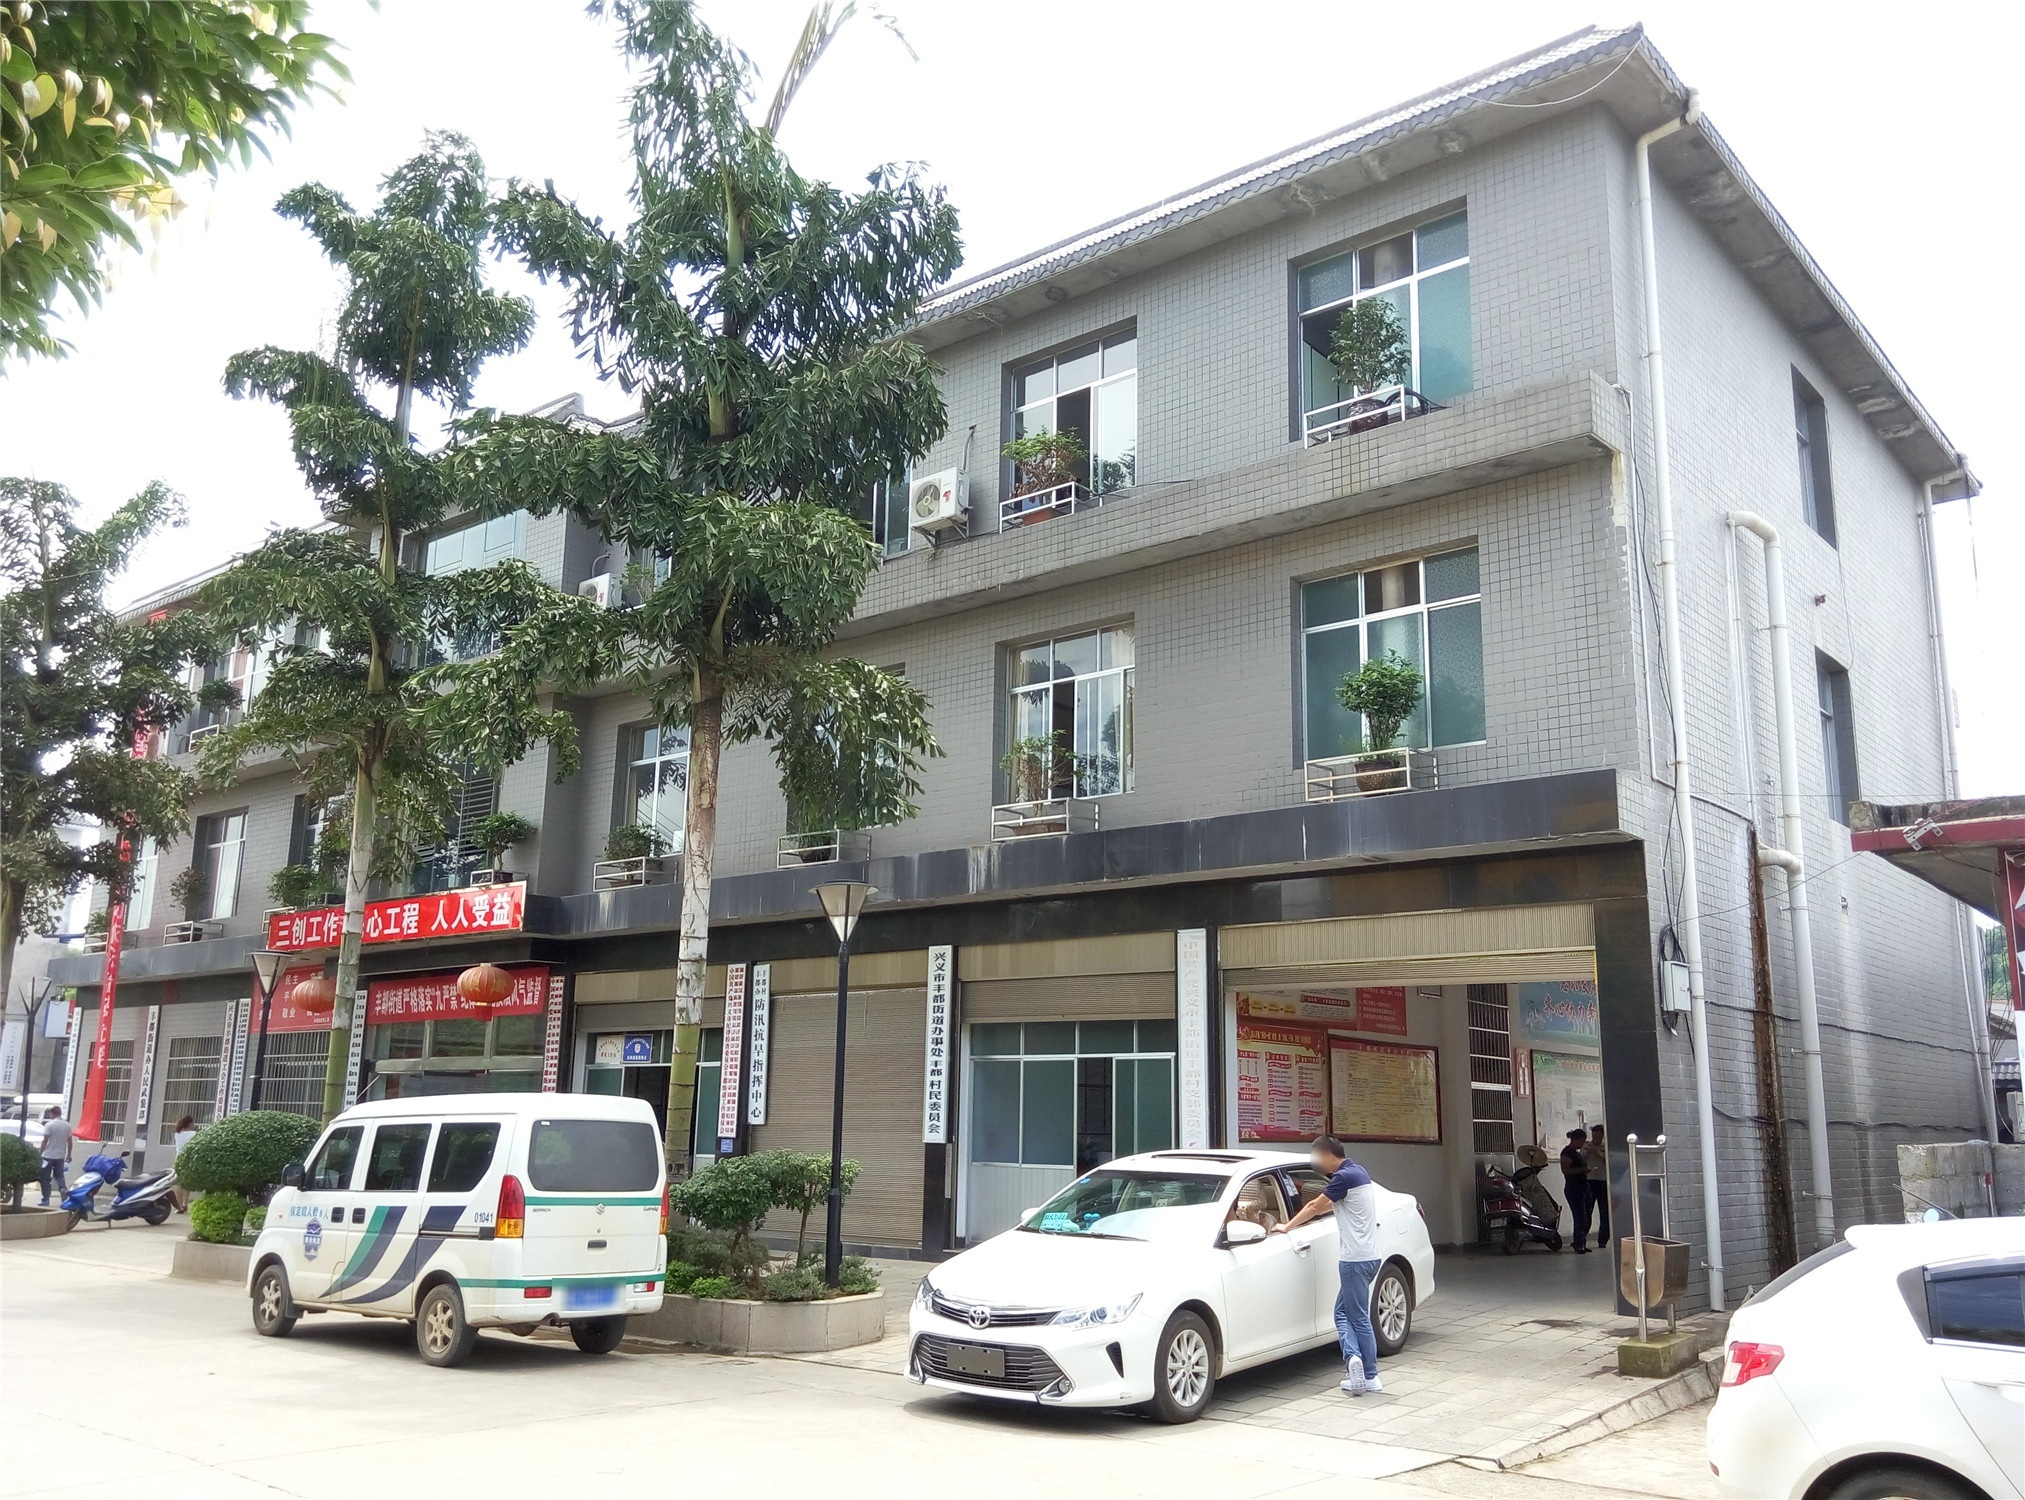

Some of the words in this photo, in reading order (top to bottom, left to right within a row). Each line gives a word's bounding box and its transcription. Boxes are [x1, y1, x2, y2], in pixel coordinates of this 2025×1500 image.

[276, 902, 419, 947] 三创工作心工程
[431, 892, 511, 932] 人人受益
[750, 998, 765, 1118] 防汛抗旱指挥中心
[928, 951, 947, 1134] 兴义市丰都街道办事处丰都村民委员会
[474, 1212, 494, 1224] 01041
